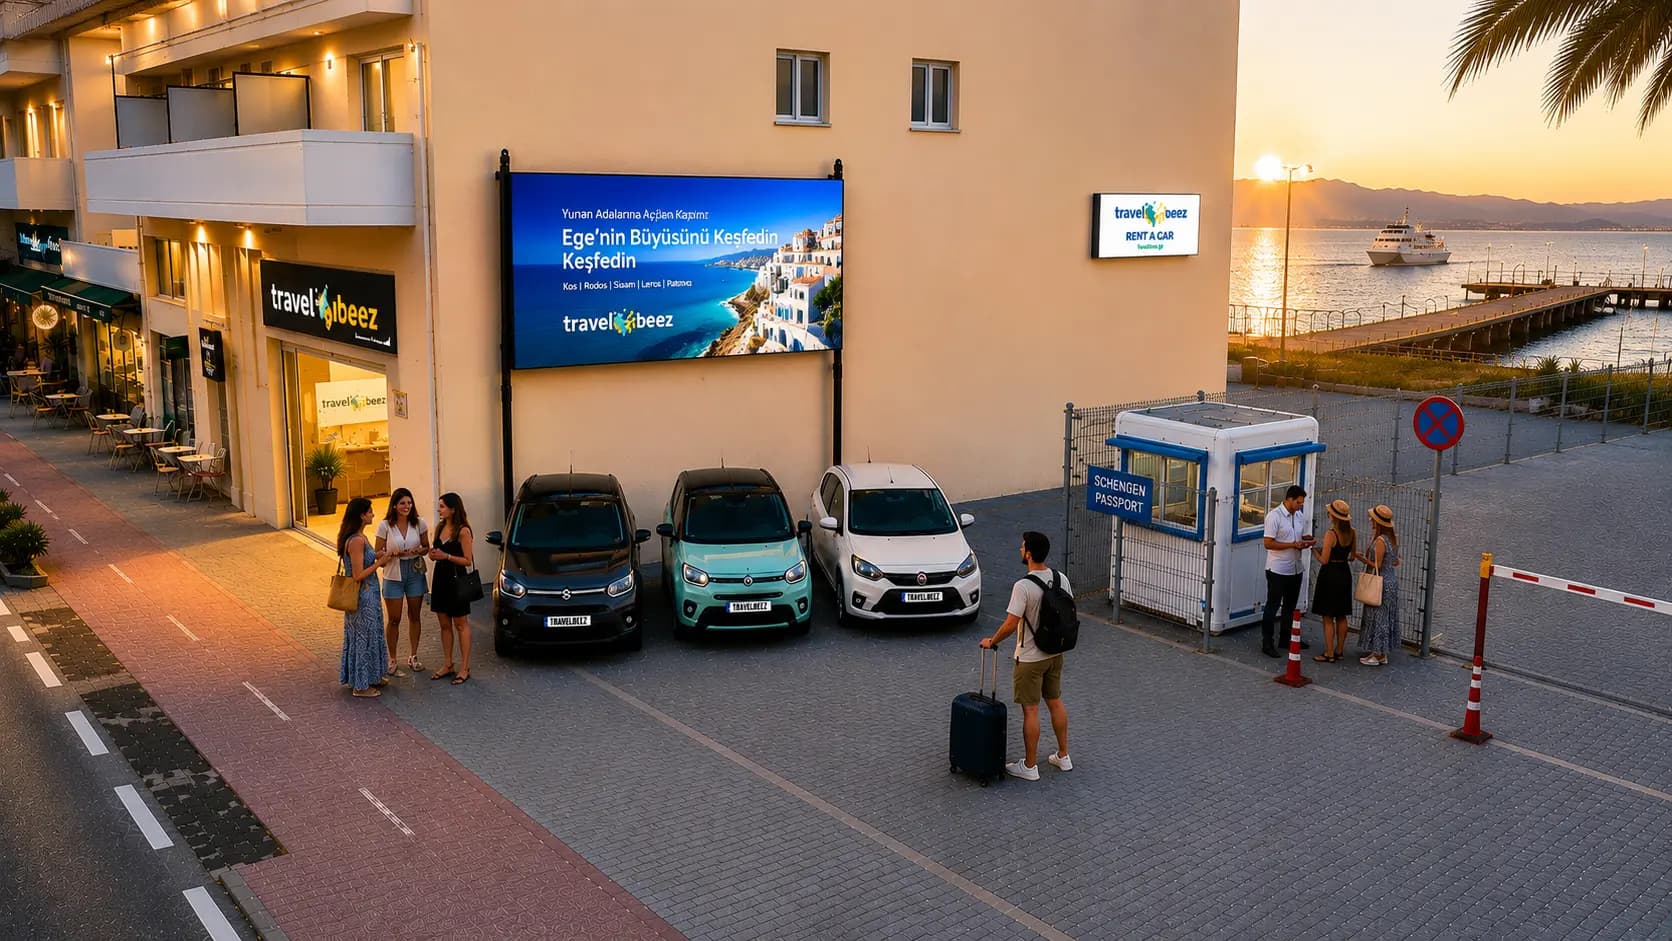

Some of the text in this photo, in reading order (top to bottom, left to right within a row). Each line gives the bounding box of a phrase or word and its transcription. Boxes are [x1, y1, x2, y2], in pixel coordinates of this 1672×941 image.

[562, 208, 593, 219] Yunan
[1115, 205, 1145, 219] travel
[562, 228, 778, 250] Ege’nin Büyüsünü Keşfedin
[1126, 231, 1148, 241] RENT
[1149, 231, 1156, 241] A
[562, 252, 636, 273] Keşfedin
[563, 282, 578, 291] Kos
[584, 282, 608, 290] Rodos
[271, 283, 315, 317] travel
[563, 312, 673, 332] travel beez
[322, 396, 350, 408] travel
[1094, 475, 1146, 497] SCHENGEN
[1095, 492, 1144, 513] PASSPORT
